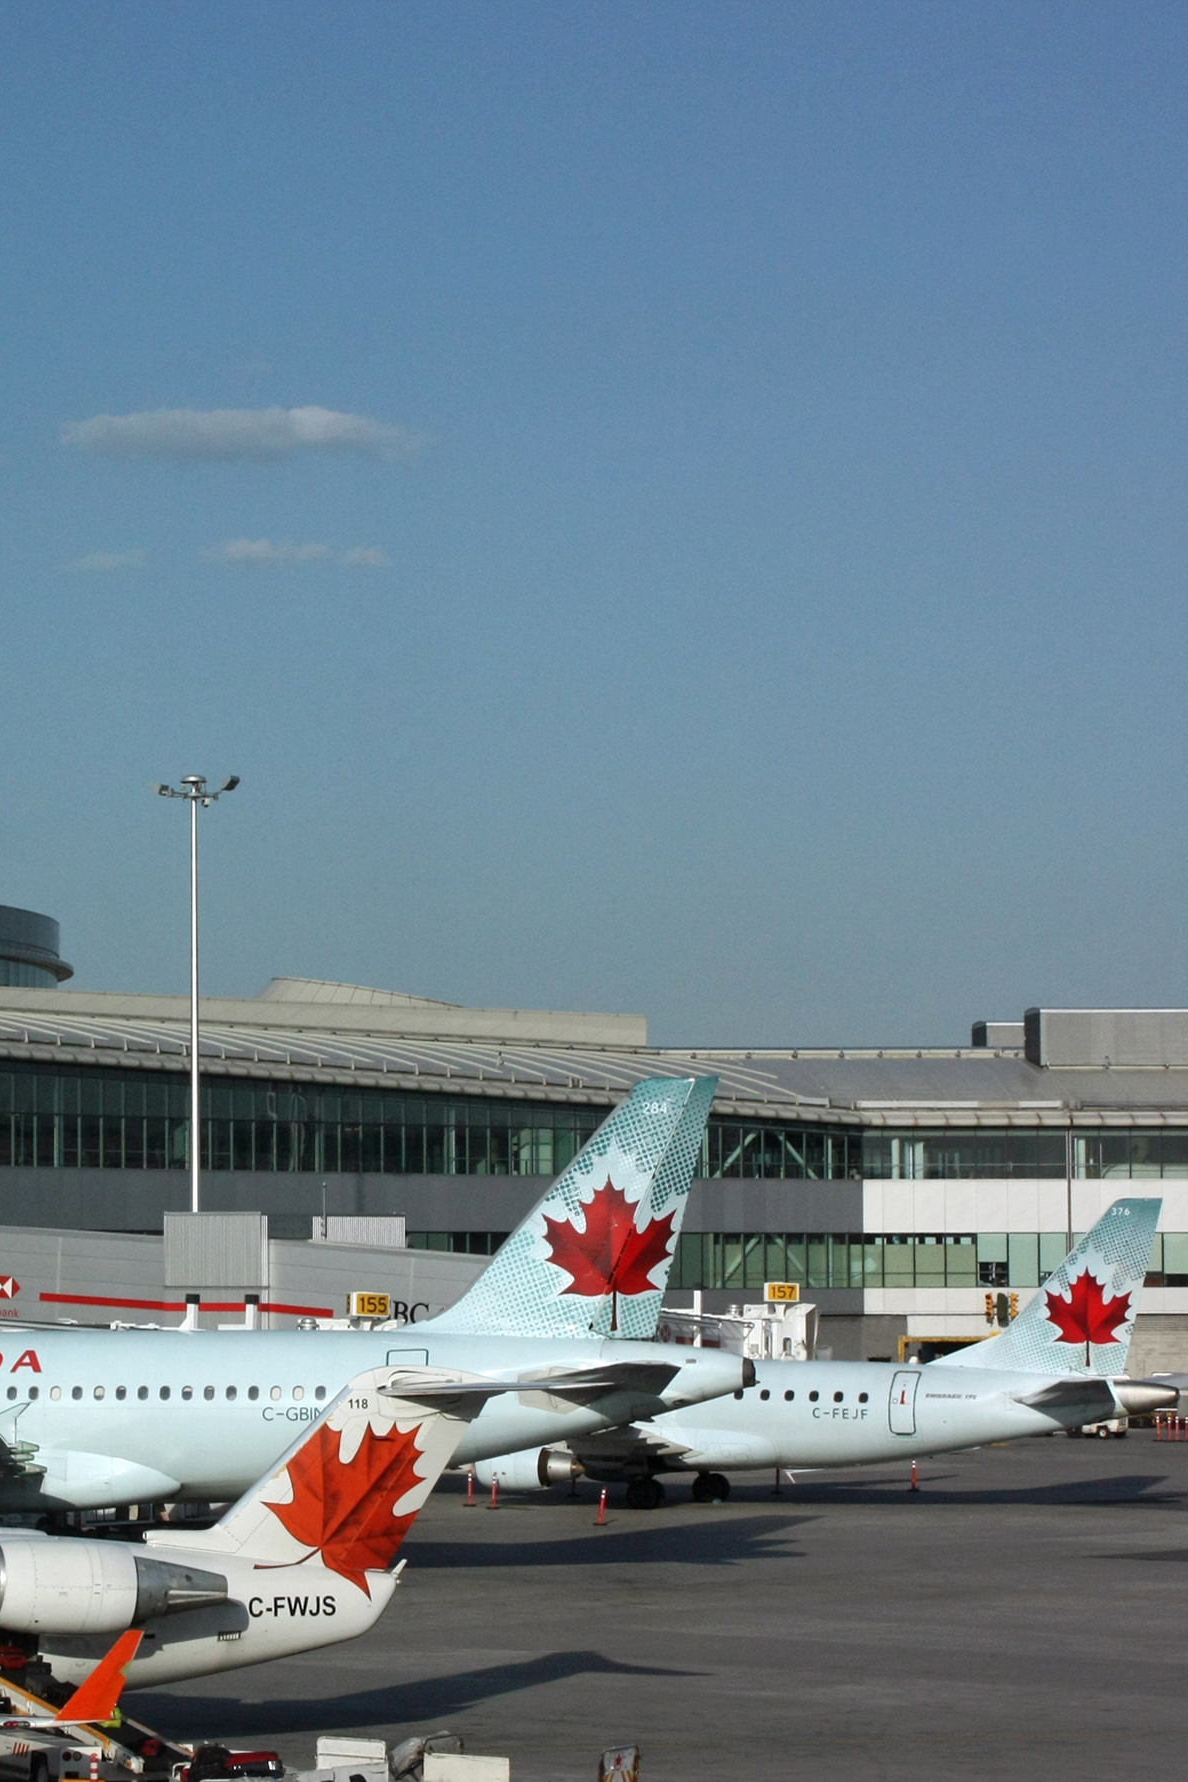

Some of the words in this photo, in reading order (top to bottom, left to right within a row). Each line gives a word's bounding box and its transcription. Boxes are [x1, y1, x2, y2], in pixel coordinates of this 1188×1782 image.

[642, 1102, 668, 1114] 284
[1112, 1207, 1131, 1216] 376
[771, 1285, 795, 1299] 157
[359, 1296, 388, 1313] 155
[347, 1399, 369, 1410] 118
[812, 1407, 869, 1420] C-FEJF
[248, 1595, 337, 1618] C-FWJS
